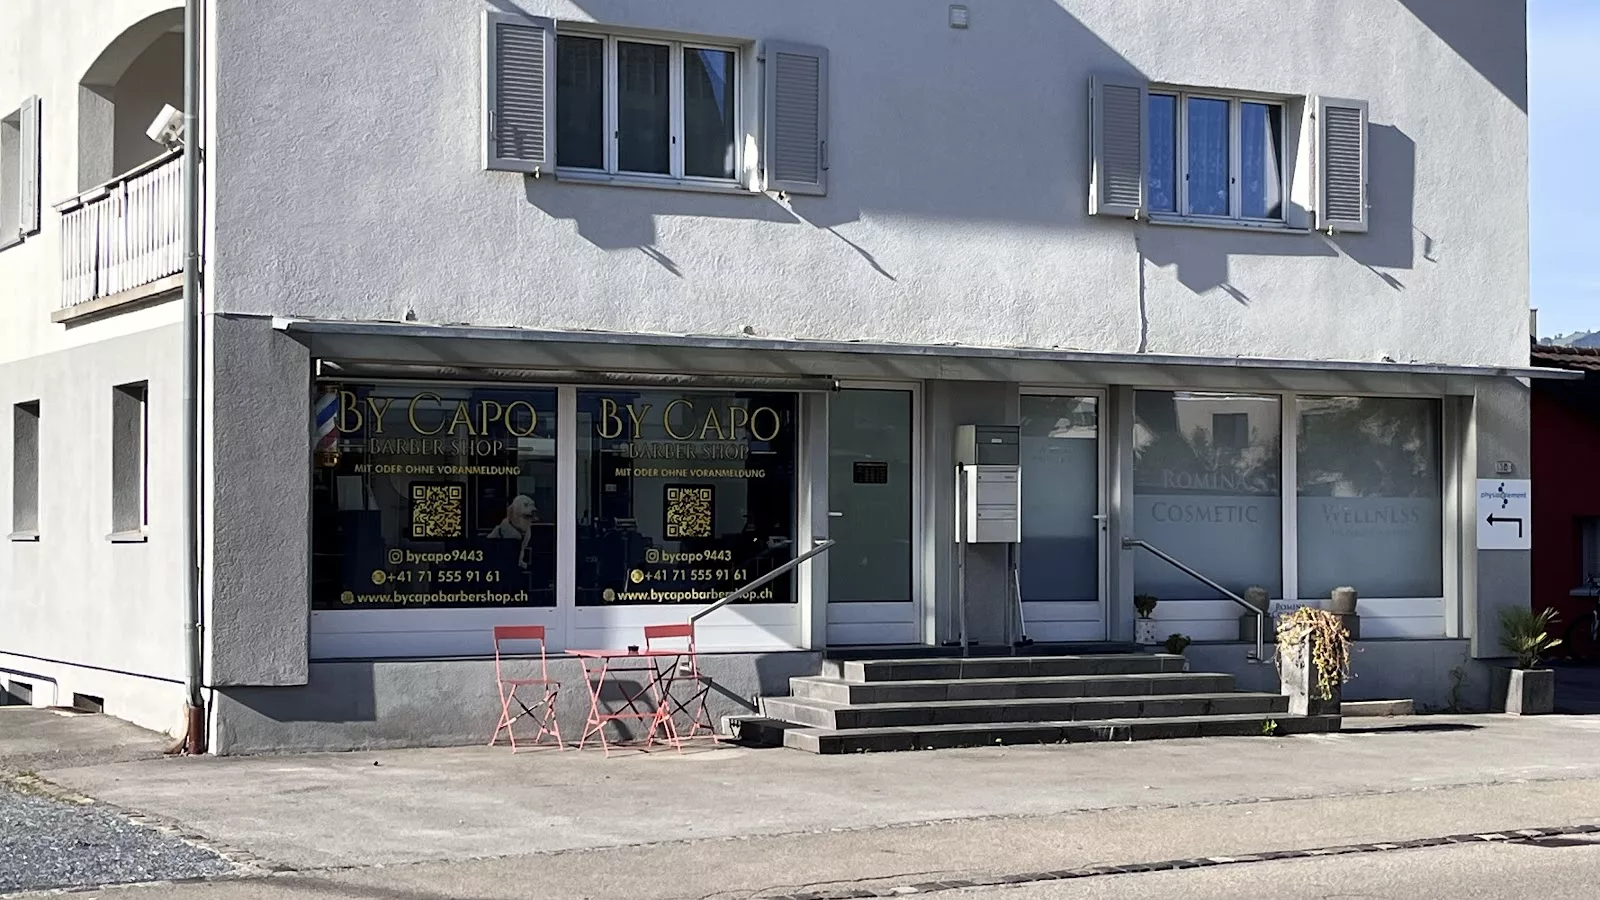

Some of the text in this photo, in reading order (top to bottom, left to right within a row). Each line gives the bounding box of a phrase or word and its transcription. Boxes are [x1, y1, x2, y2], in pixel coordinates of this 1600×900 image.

[408, 392, 538, 437] CAPO
[597, 398, 781, 441] BY CAPO
[369, 438, 503, 456] BARBER SHOP
[629, 442, 750, 460] BARBER SHOP
[354, 464, 521, 475] MIT ODER OHNE VORANMELDUNG
[615, 468, 766, 478] MIT ODER OHNE VORANMELDUNG
[1151, 502, 1259, 523] COSMETIC
[406, 550, 484, 563] bycapo9443
[662, 550, 732, 563] bycapo9443
[387, 571, 500, 582] +41 71 555 91 61
[645, 569, 747, 581] +41 71 555 91 61
[357, 590, 528, 605] www.bycapobarbershop.ch
[617, 588, 773, 603] www.bycapobarberop.ch
